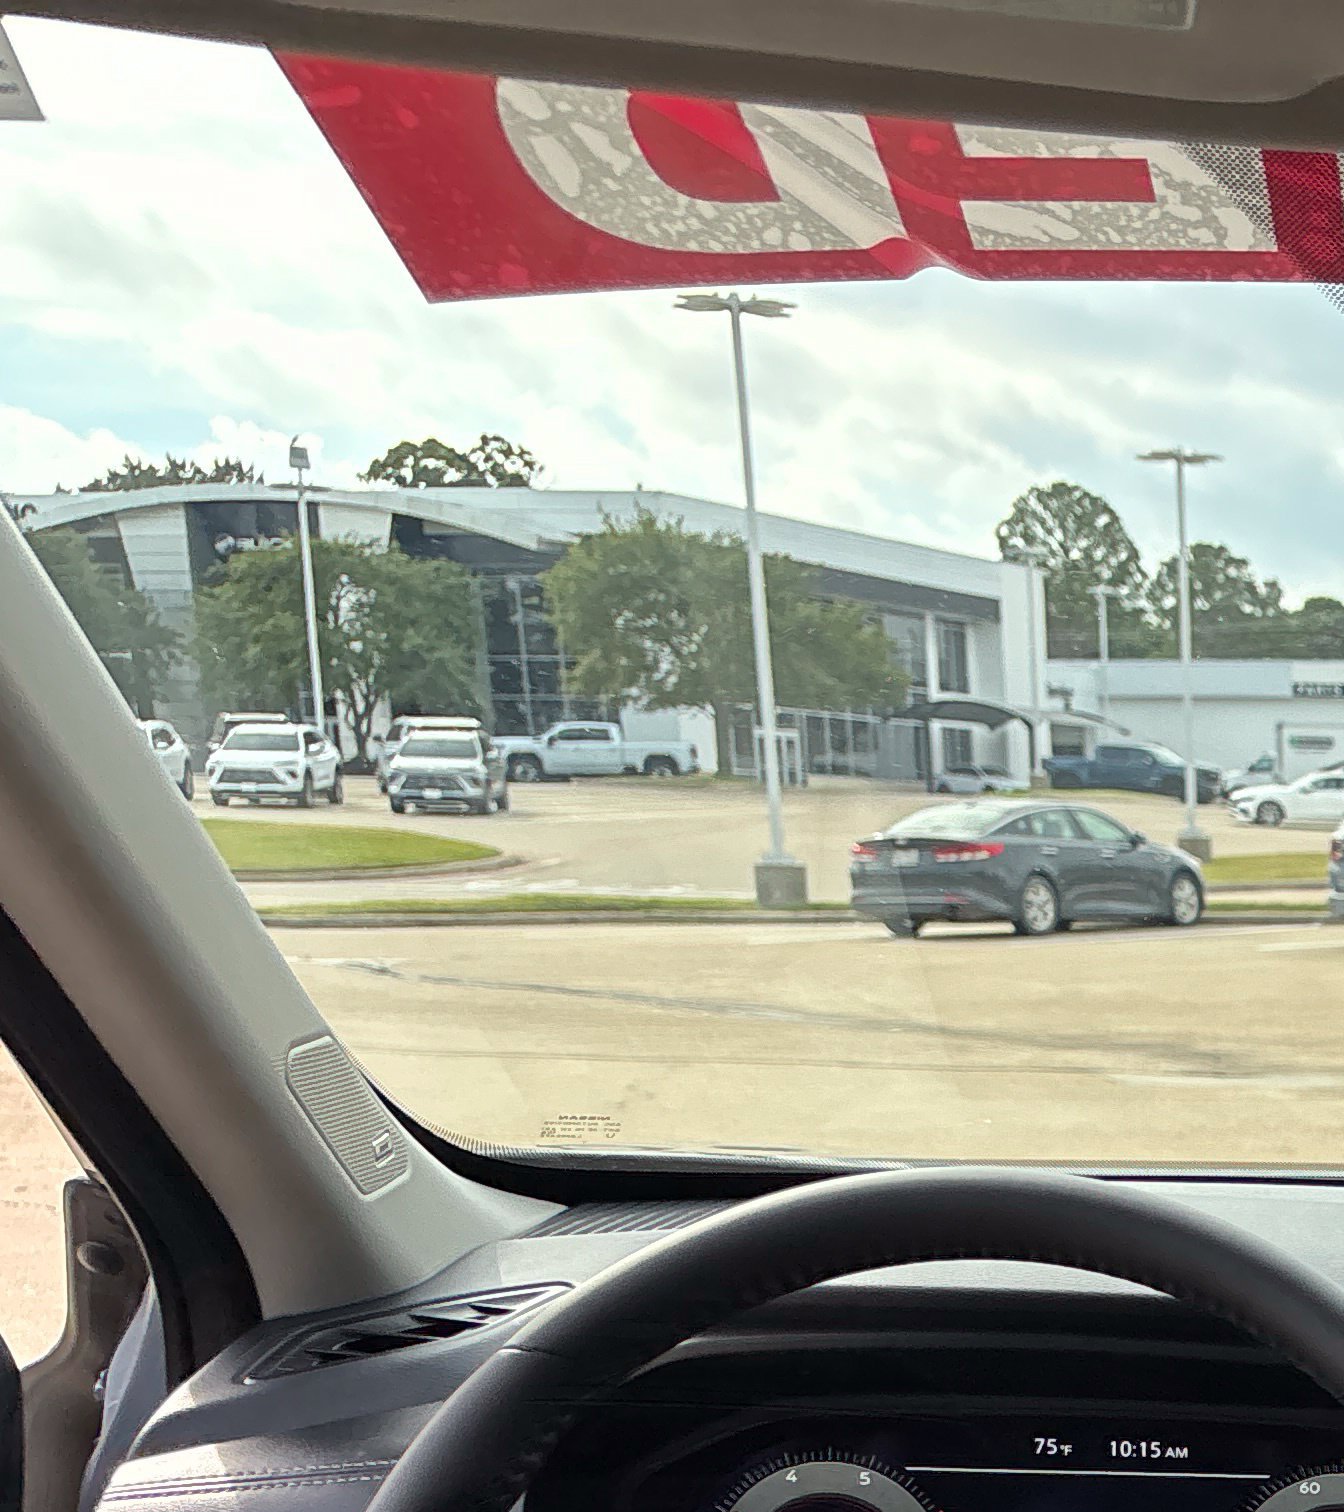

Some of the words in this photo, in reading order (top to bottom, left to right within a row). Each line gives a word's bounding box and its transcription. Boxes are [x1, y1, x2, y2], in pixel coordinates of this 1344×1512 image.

[1110, 1440, 1162, 1458] 10:15
[1165, 1447, 1188, 1458] AM
[785, 1469, 797, 1483] 4
[859, 1471, 871, 1486] 5
[1299, 1481, 1321, 1495] 60
